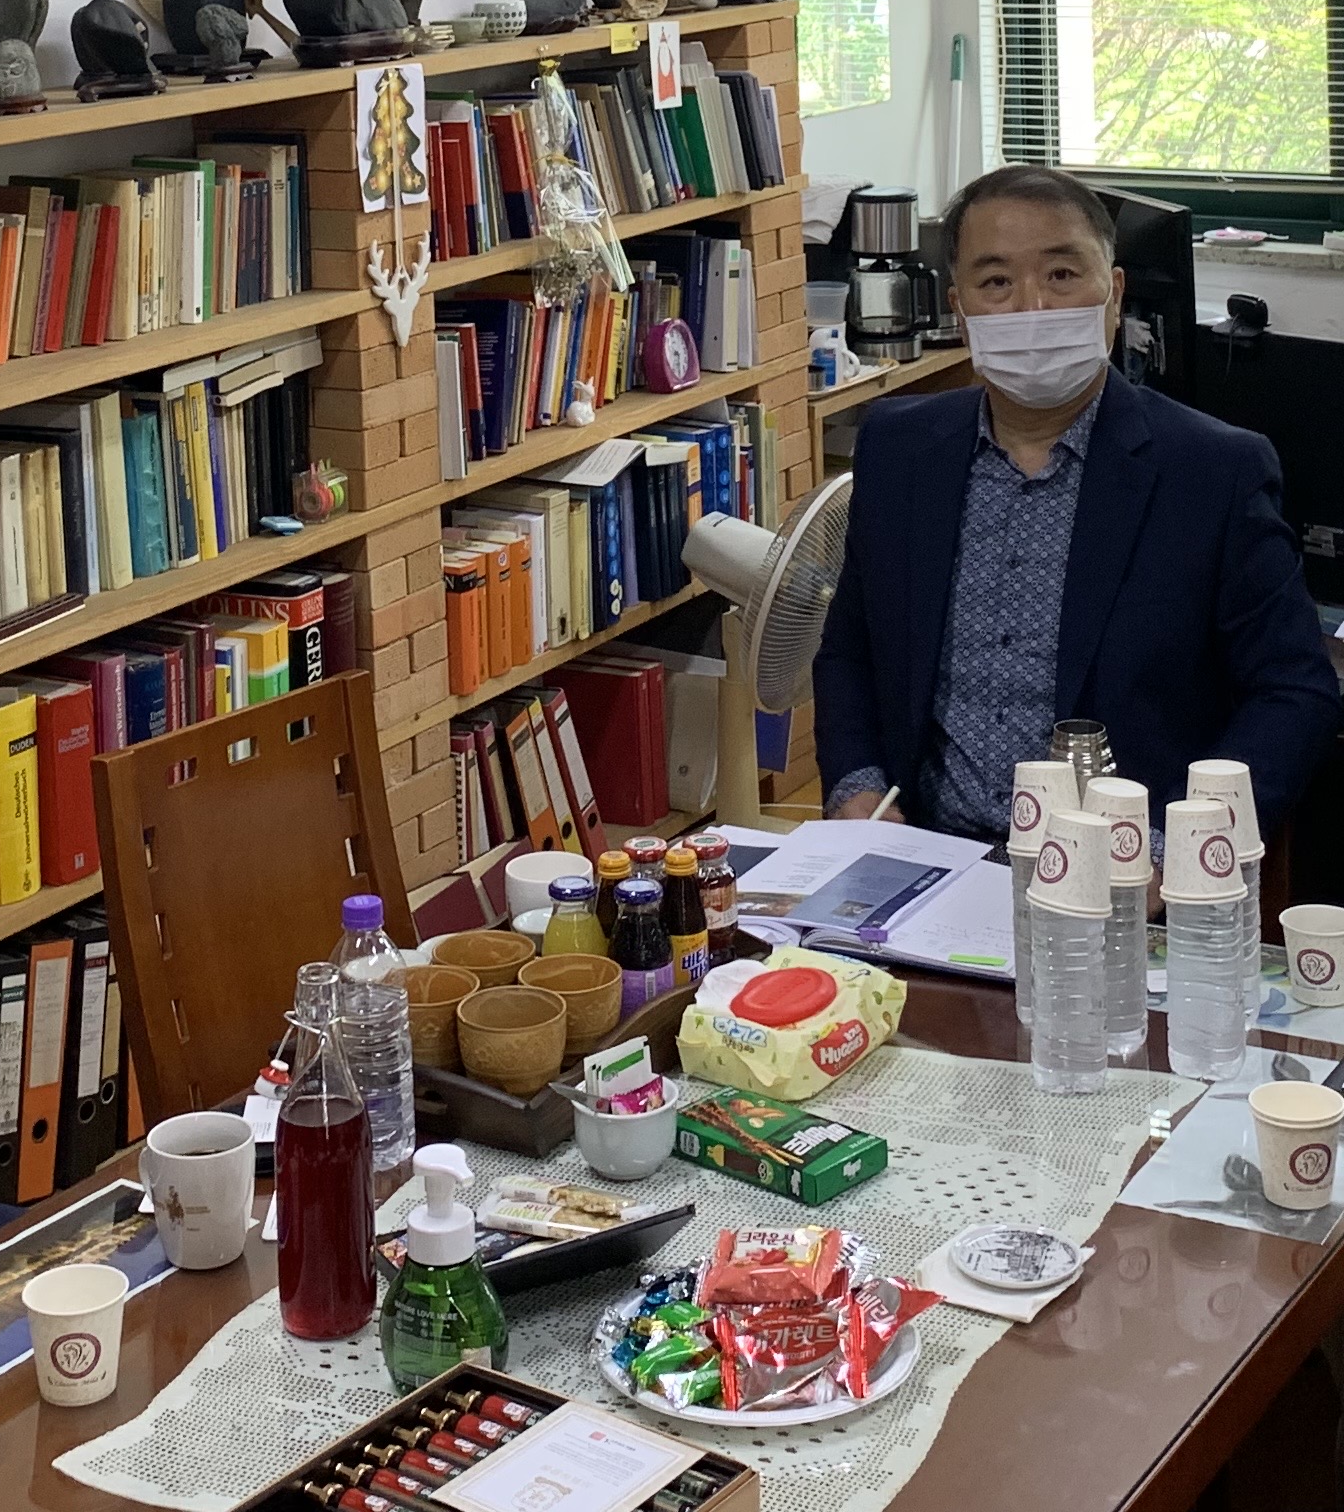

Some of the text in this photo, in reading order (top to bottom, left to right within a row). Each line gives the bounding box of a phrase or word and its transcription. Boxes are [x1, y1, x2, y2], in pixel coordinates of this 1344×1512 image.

[306, 626, 323, 685] GER
[10, 738, 36, 753] DUDEN
[21, 768, 32, 864] Universalwörterbuch
[737, 1230, 798, 1246] 크라운산
